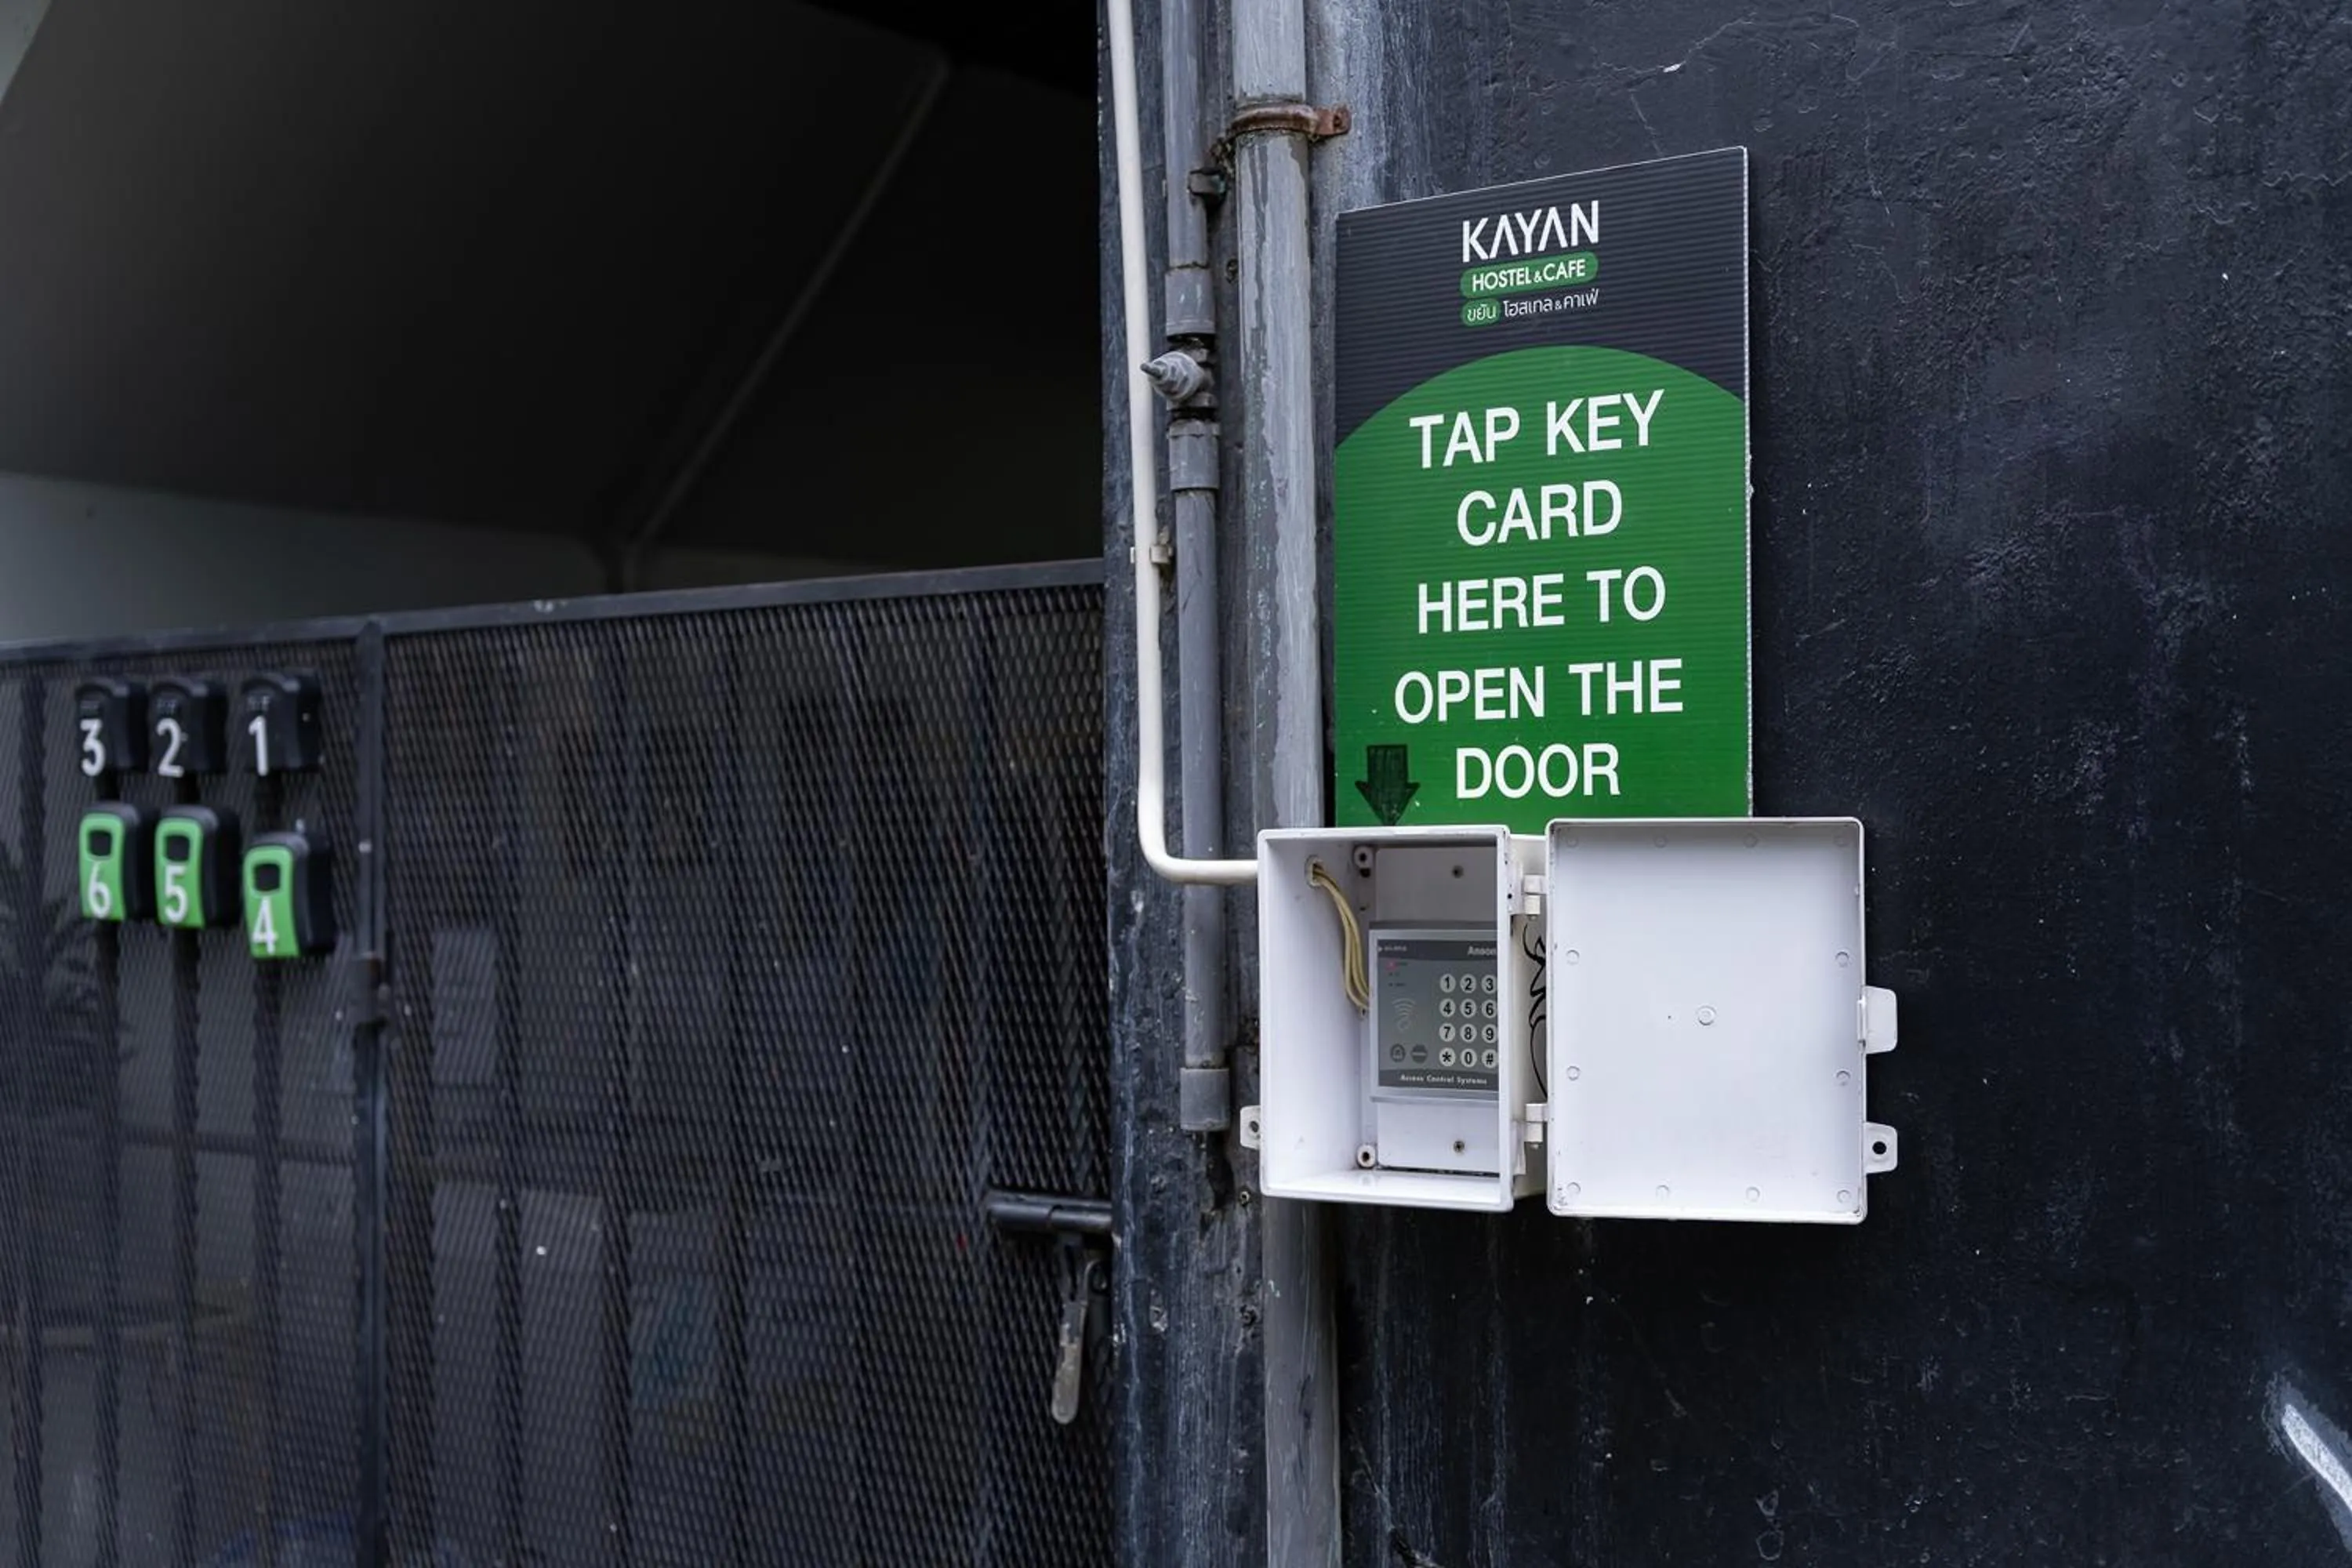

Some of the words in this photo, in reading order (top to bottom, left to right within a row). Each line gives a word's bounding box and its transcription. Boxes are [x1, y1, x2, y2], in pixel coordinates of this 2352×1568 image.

[1462, 200, 1599, 263] KAYAN
[1409, 406, 1520, 469] TAP
[1547, 389, 1665, 456] KEY
[1457, 479, 1623, 546] CARD
[1417, 573, 1566, 634] HERE
[1586, 565, 1667, 622] TO
[1394, 665, 1545, 724] OPEN
[1569, 658, 1684, 717] THE
[80, 718, 106, 776] 3
[157, 717, 185, 778] 2
[248, 715, 269, 776] 1
[1456, 742, 1621, 800] DOOR
[88, 862, 111, 918] 6
[164, 864, 188, 923] 5
[251, 896, 278, 954] 4
[1443, 1003, 1451, 1014] 4
[1465, 1003, 1472, 1016] 5
[1486, 1005, 1494, 1018] 6
[1444, 977, 1450, 989] 1
[1465, 978, 1472, 990] 2
[1486, 978, 1494, 991] 3
[1443, 1027, 1450, 1039] 7
[1465, 1027, 1472, 1040] 8
[1486, 1029, 1494, 1041] 9
[1465, 1051, 1472, 1064] 0
